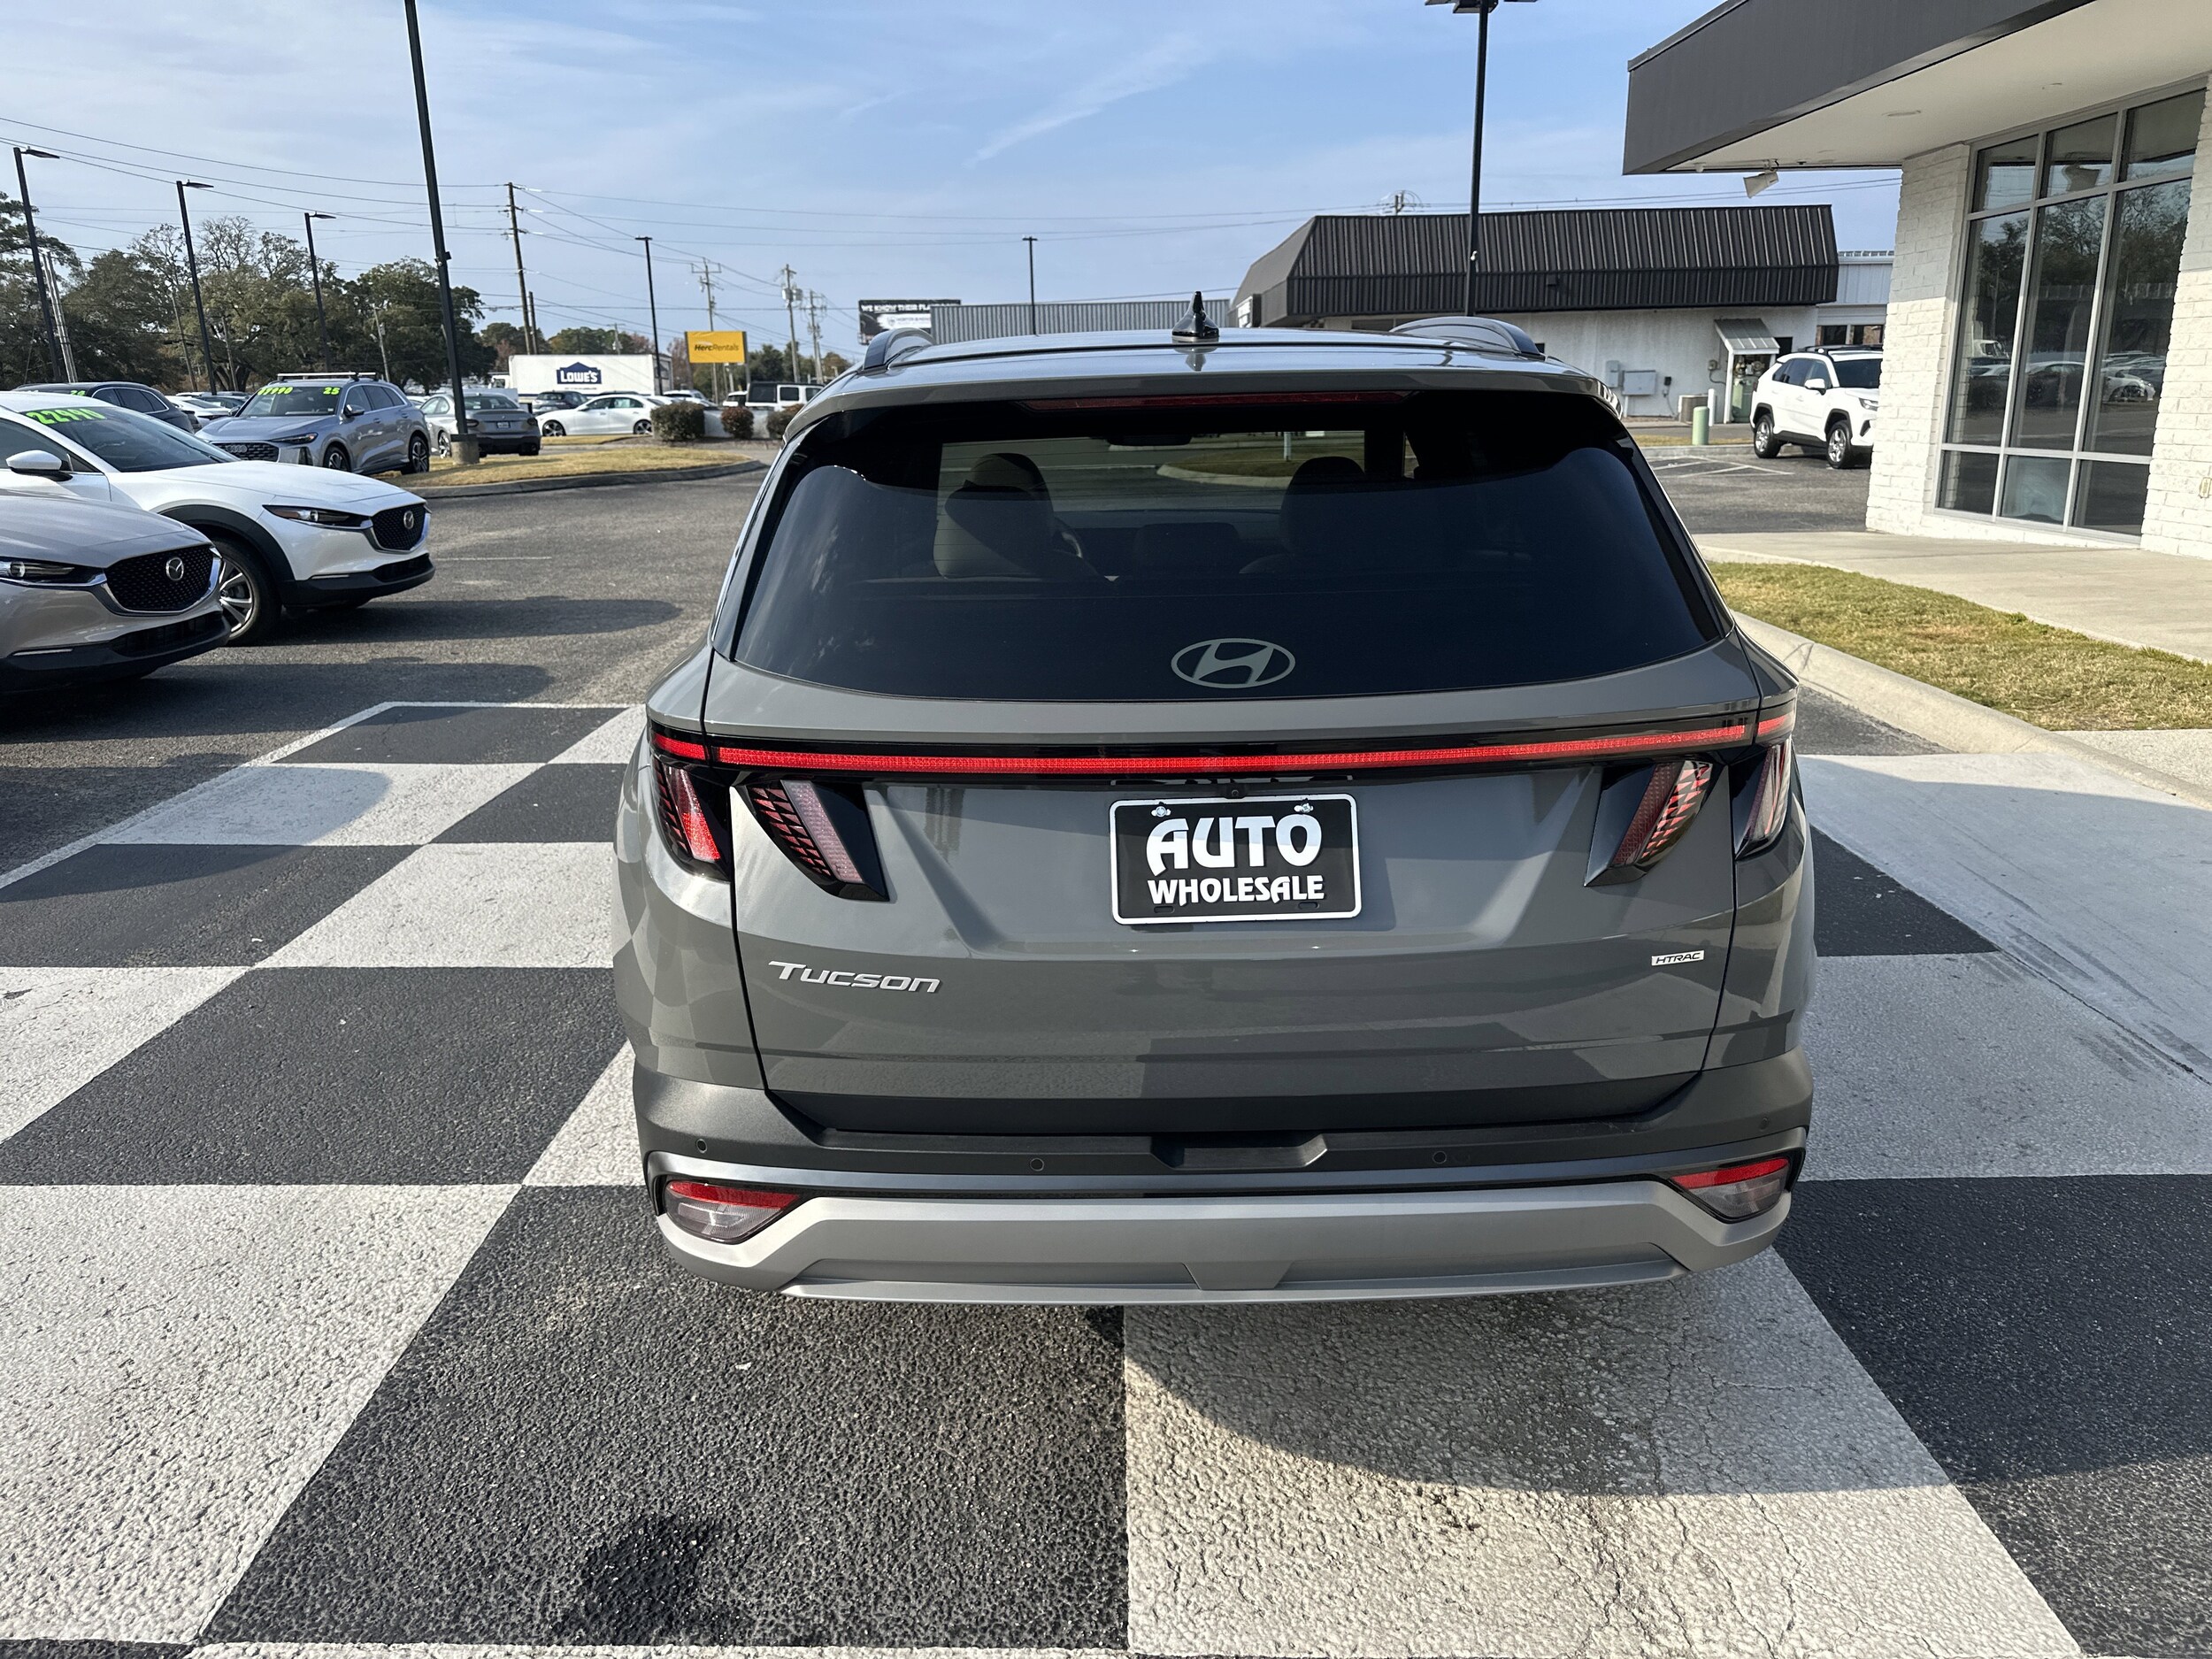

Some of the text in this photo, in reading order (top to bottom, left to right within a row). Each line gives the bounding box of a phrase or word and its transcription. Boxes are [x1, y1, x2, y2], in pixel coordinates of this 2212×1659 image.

[560, 370, 598, 383] LOWE'S
[26, 408, 107, 425] 22990
[1146, 814, 1322, 877] AUTO
[1147, 875, 1325, 906] WHOLESALE
[1655, 952, 1701, 964] HTRAC
